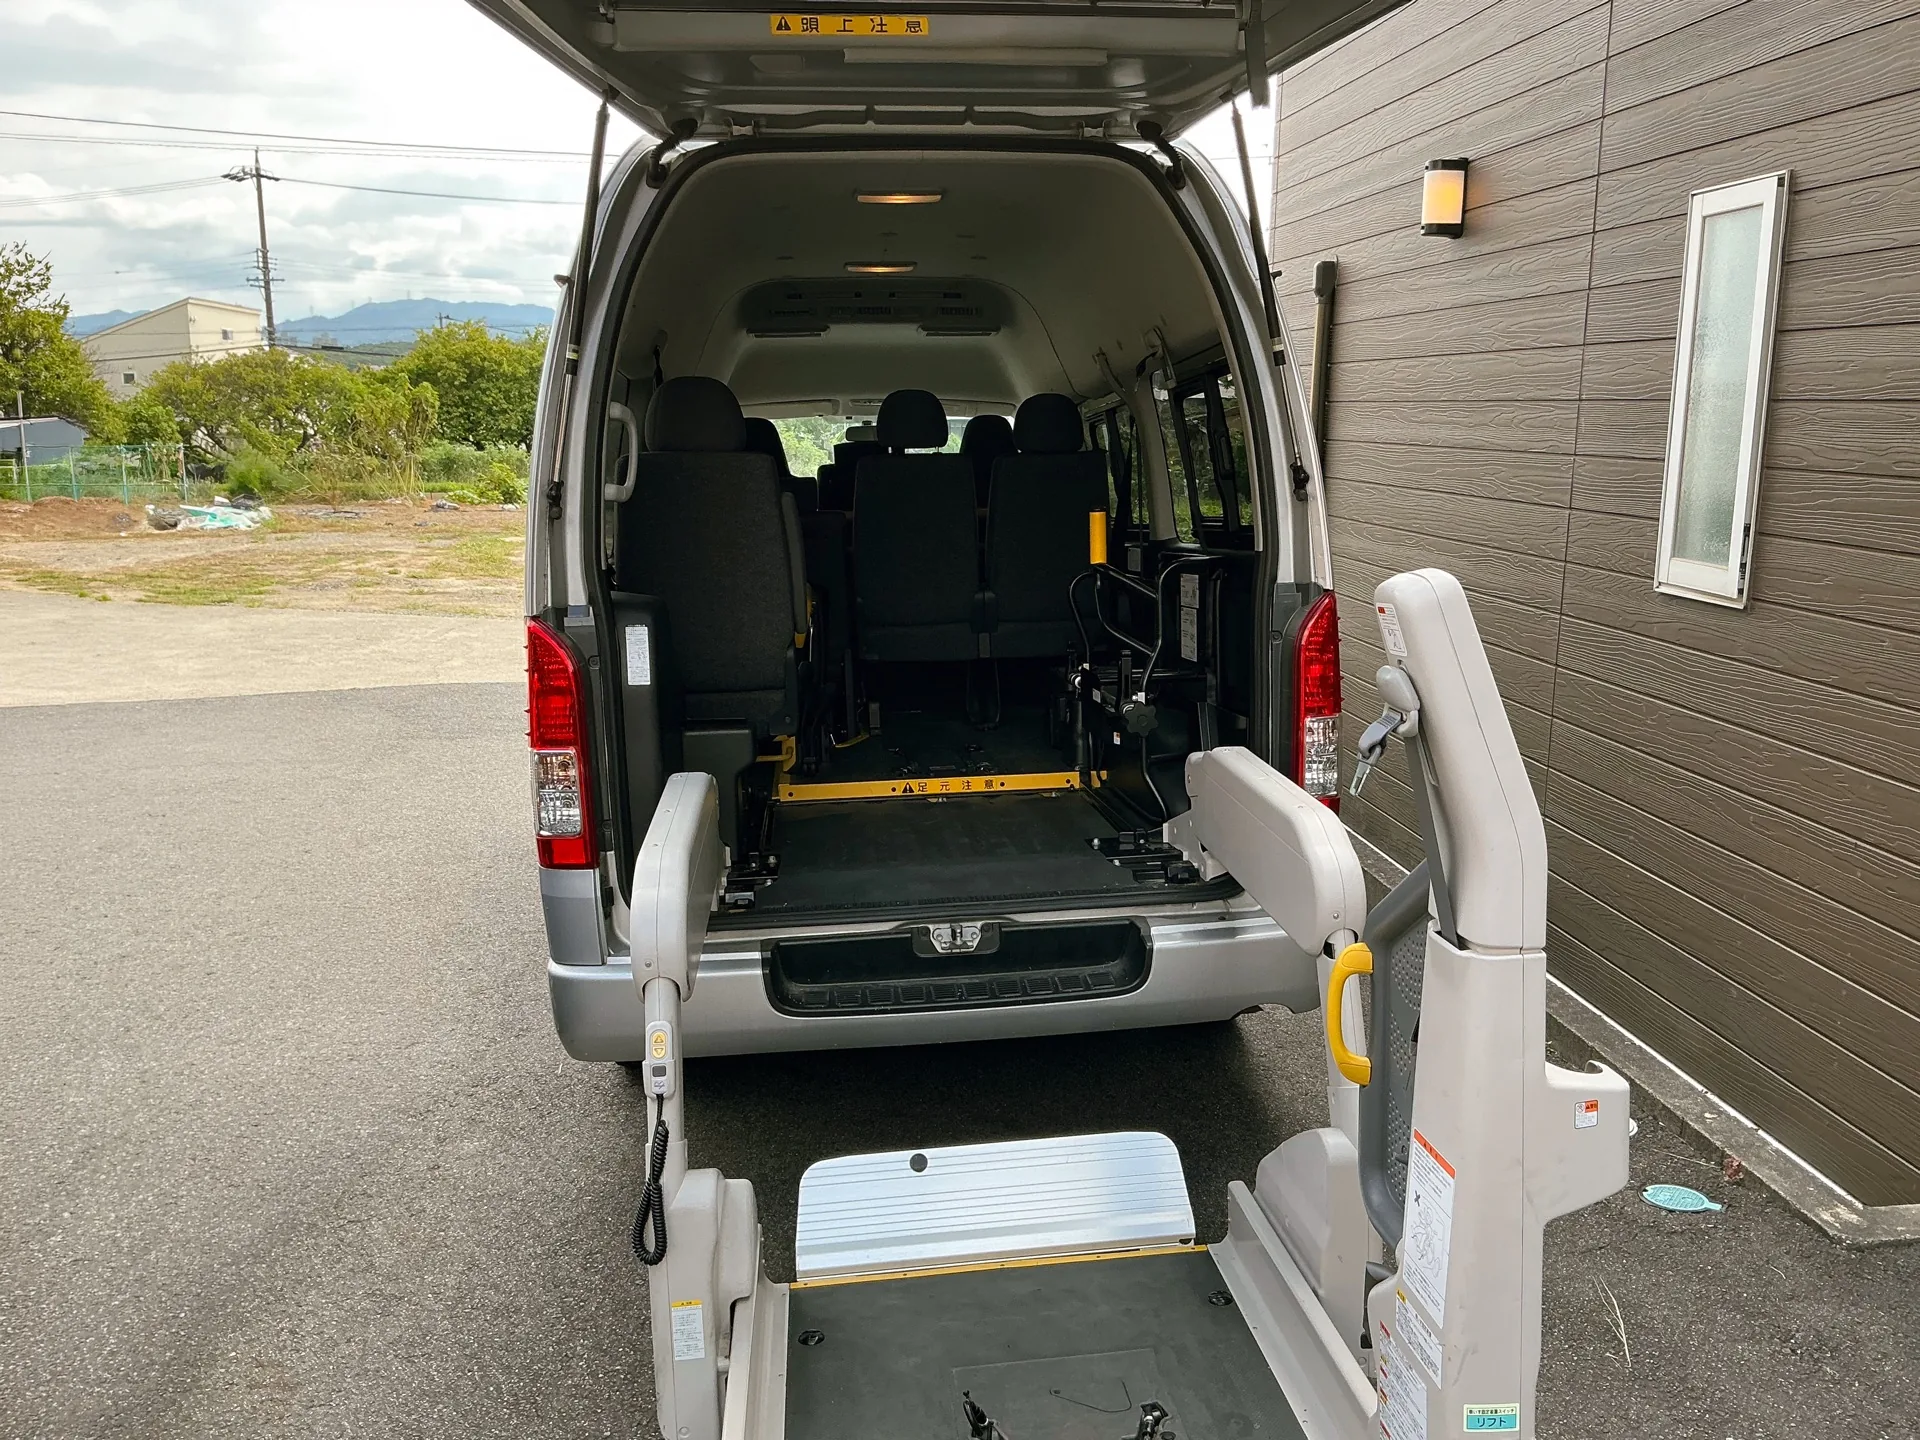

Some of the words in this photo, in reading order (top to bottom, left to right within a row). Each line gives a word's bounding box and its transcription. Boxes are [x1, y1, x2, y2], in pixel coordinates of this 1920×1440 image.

[917, 779, 994, 792] 足元注意
[1477, 1417, 1507, 1427] リフト
